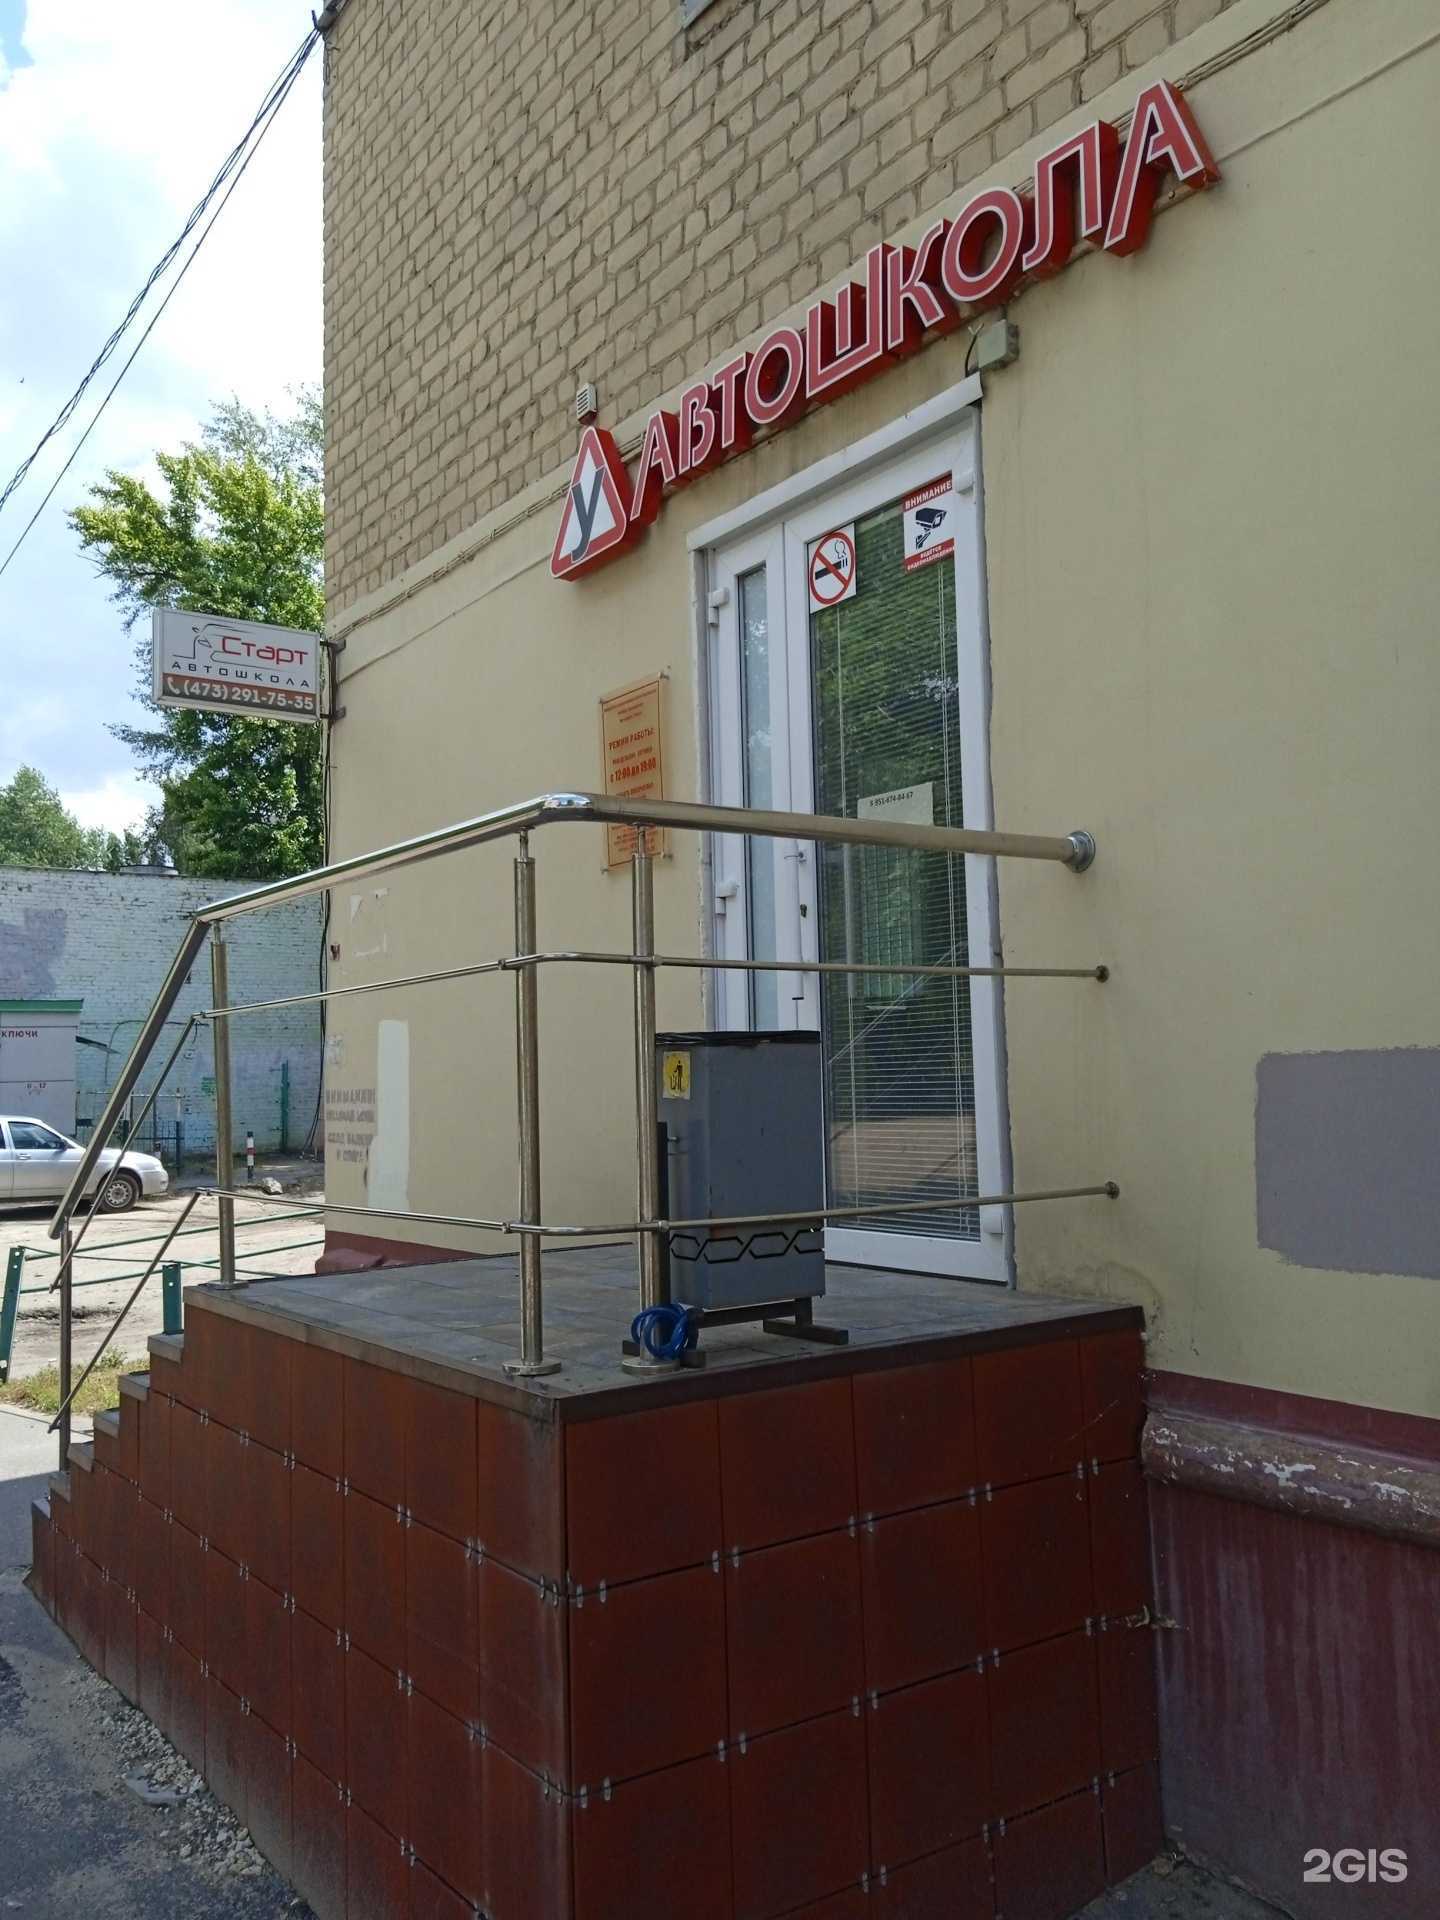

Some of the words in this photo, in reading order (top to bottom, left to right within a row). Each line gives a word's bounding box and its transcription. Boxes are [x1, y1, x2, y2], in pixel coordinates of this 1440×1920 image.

[630, 79, 1213, 522] АВТОШКОЛА
[905, 480, 952, 510] ВНИМАНИЕ
[222, 635, 309, 665] Старт
[171, 660, 310, 688] АВТОШКОЛА
[184, 678, 228, 701] (473)
